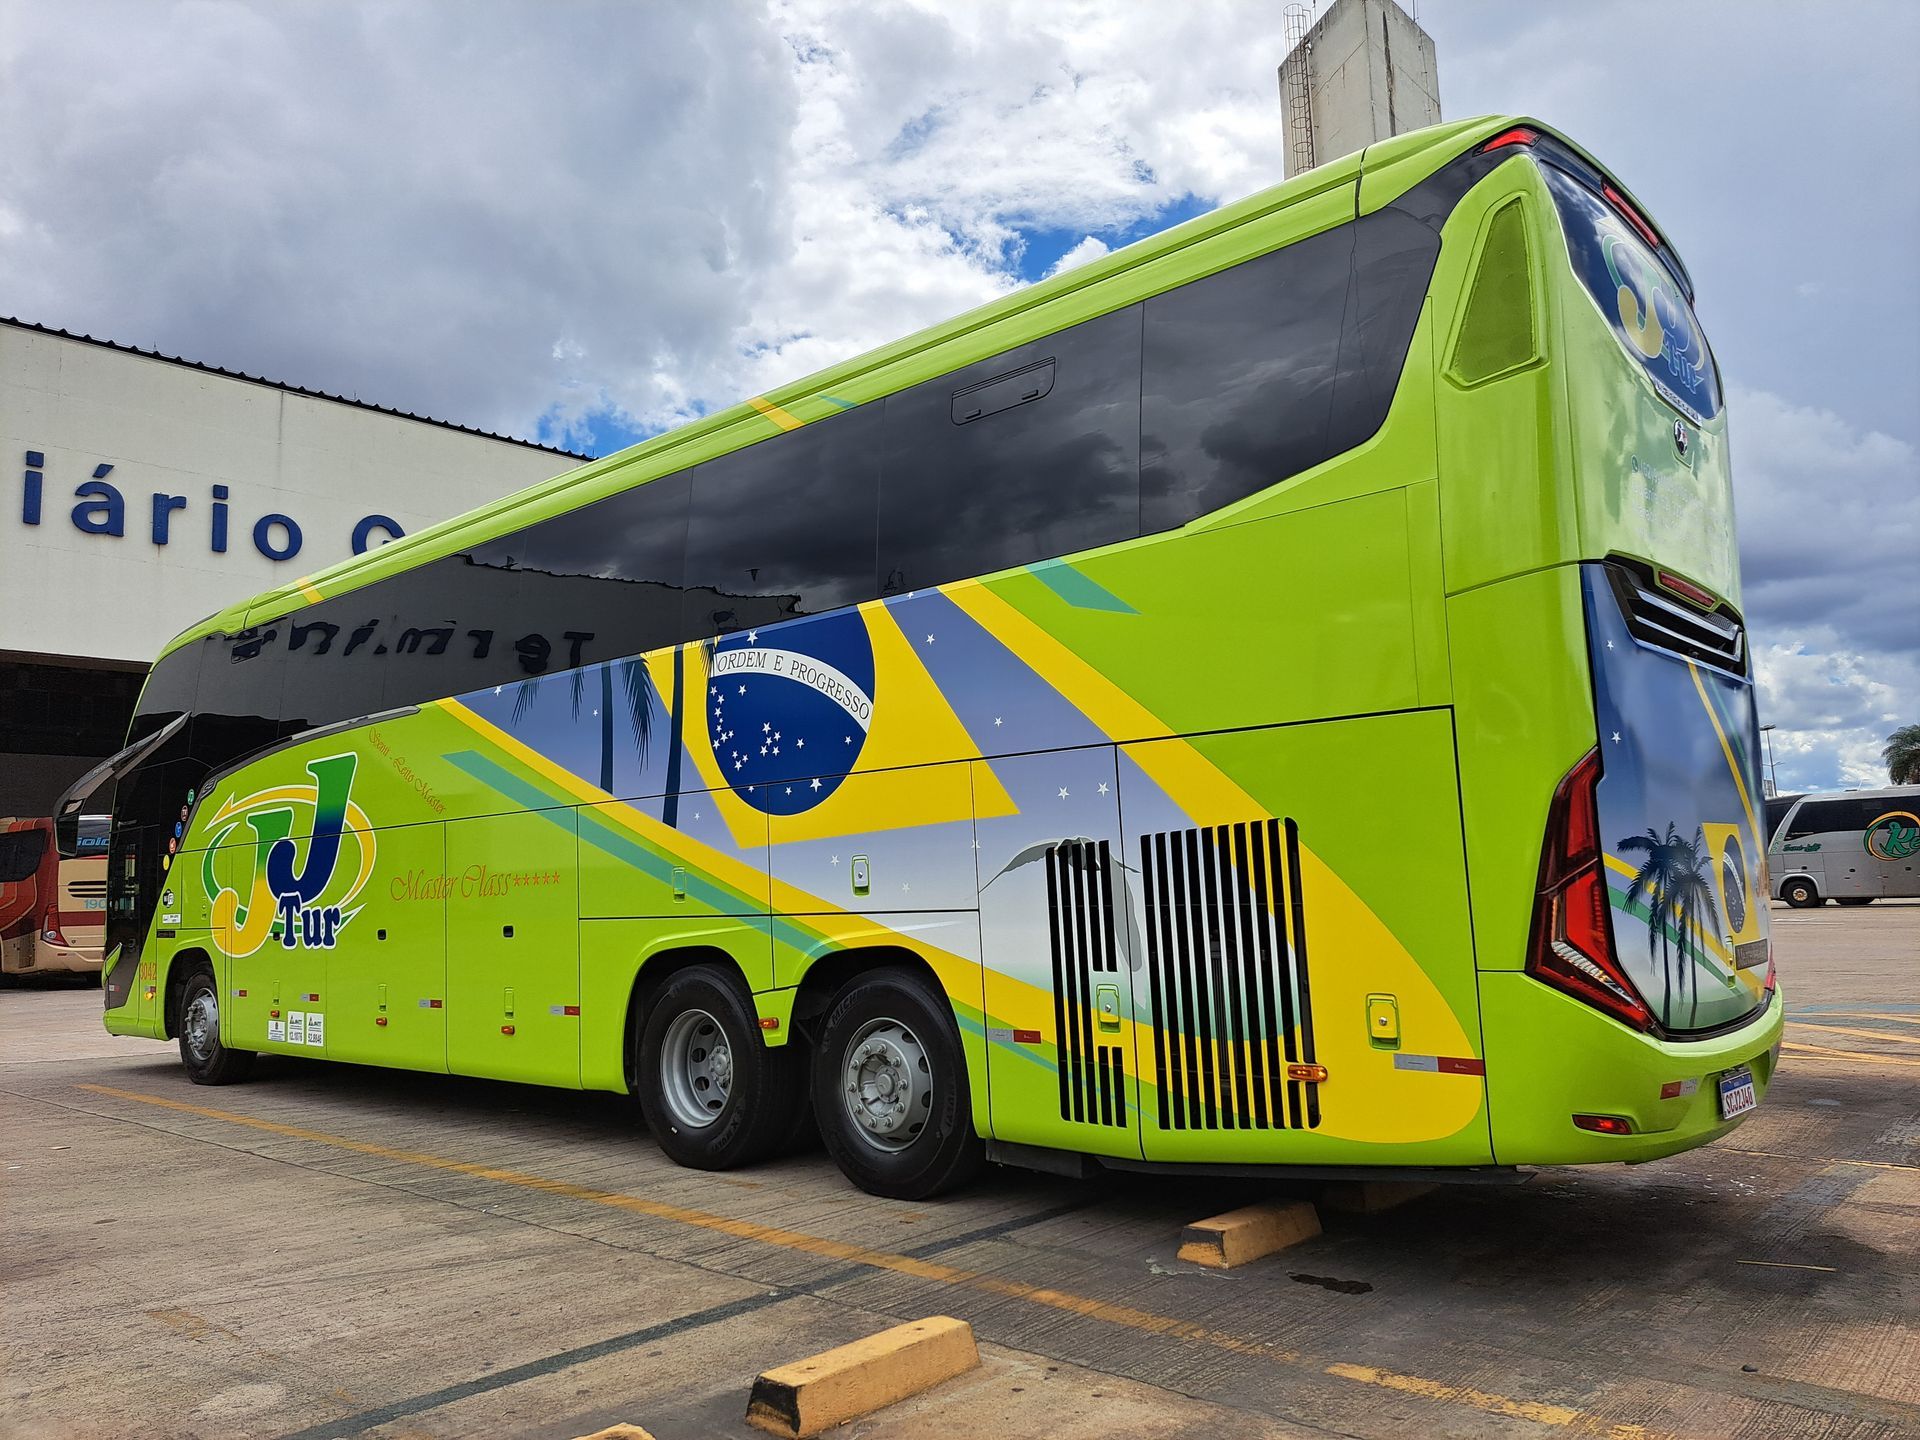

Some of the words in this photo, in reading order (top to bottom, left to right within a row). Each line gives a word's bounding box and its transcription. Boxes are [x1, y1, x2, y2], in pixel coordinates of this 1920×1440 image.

[717, 651, 768, 672] ORDEM
[773, 655, 784, 672] E
[790, 660, 870, 720] PROGRESSO
[390, 869, 458, 901] Master
[460, 864, 511, 898] Class
[278, 891, 341, 949] Tur
